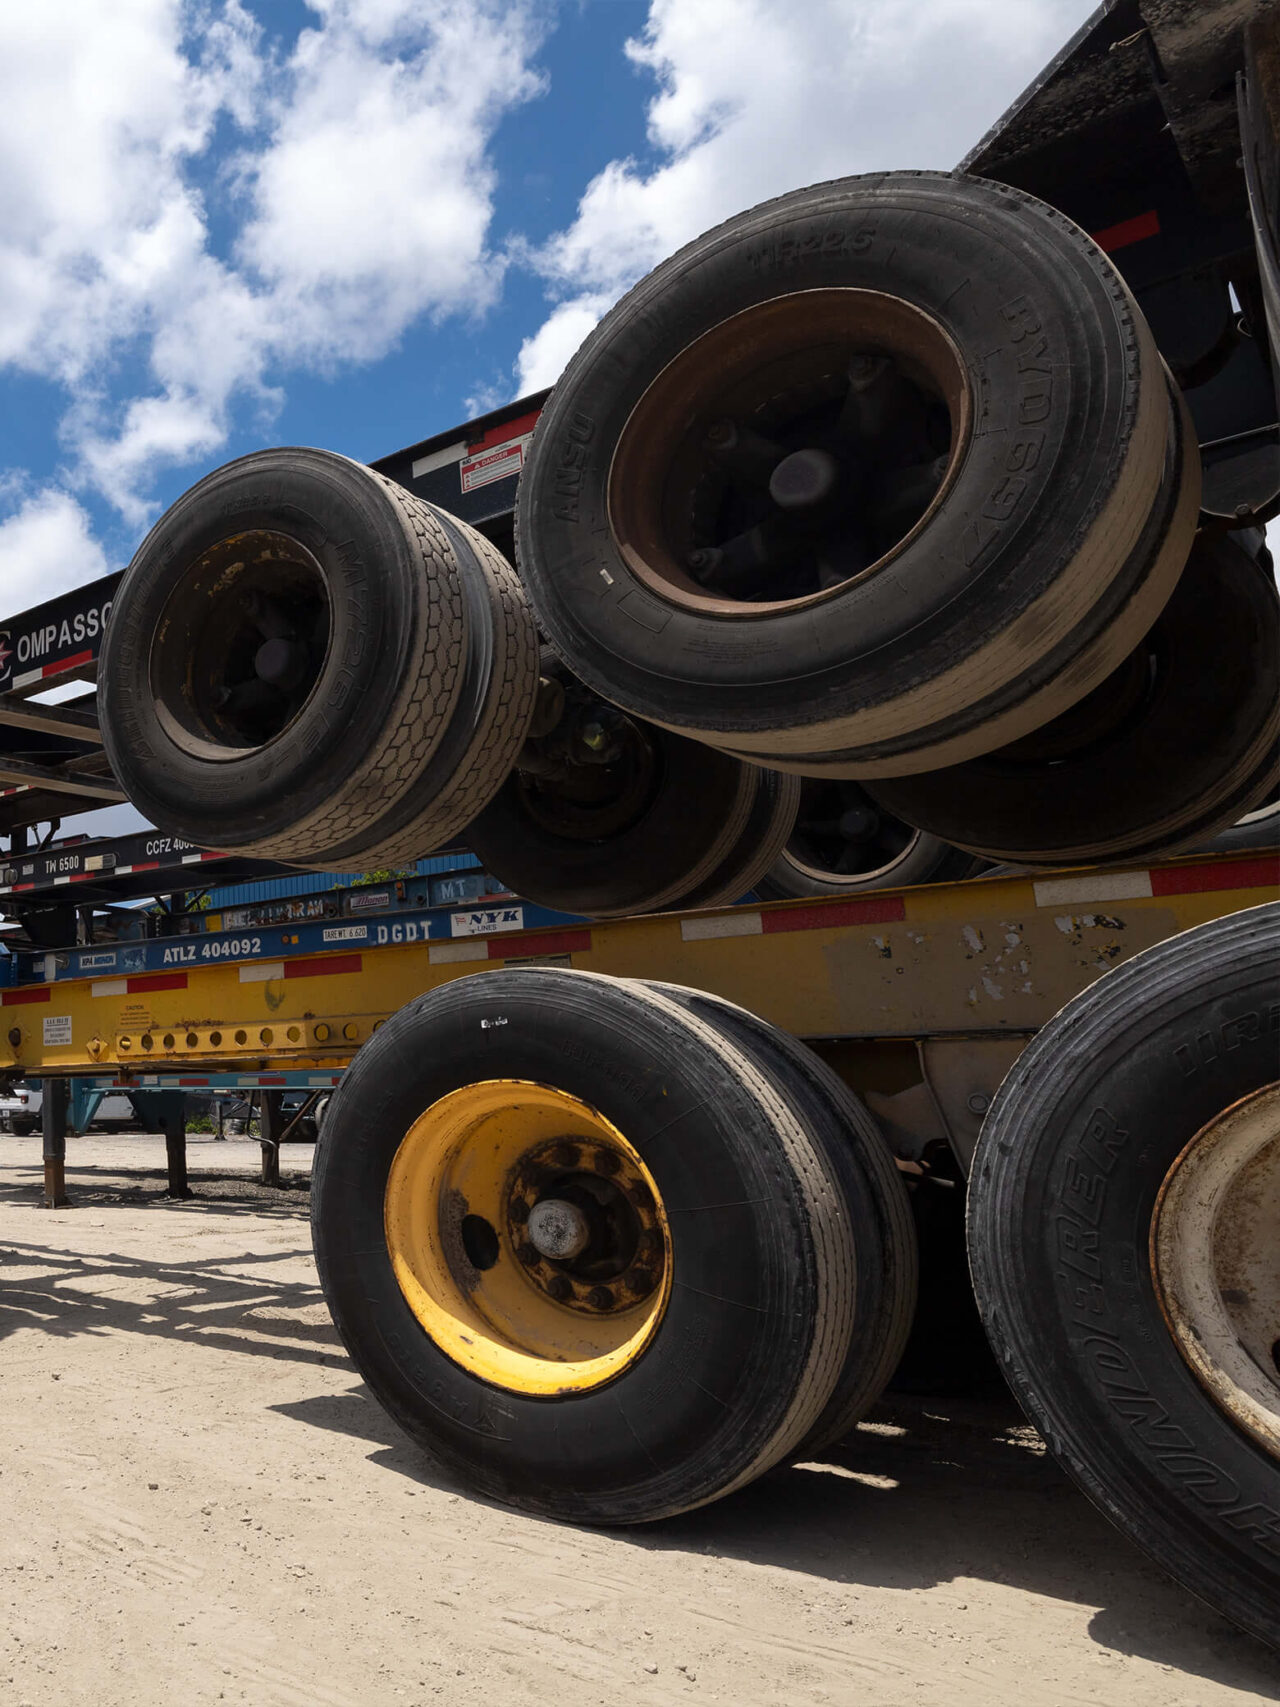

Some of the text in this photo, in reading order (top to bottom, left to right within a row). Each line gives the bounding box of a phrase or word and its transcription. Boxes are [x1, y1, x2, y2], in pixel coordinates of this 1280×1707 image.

[481, 451, 508, 466] DANGER
[146, 837, 172, 856] CCFZ
[45, 860, 57, 874] TW
[59, 855, 80, 872] 6500
[469, 910, 521, 926] NYK
[377, 920, 433, 944] DGDT
[477, 924, 497, 932] LINES
[163, 937, 262, 963] ATLZ 404092
